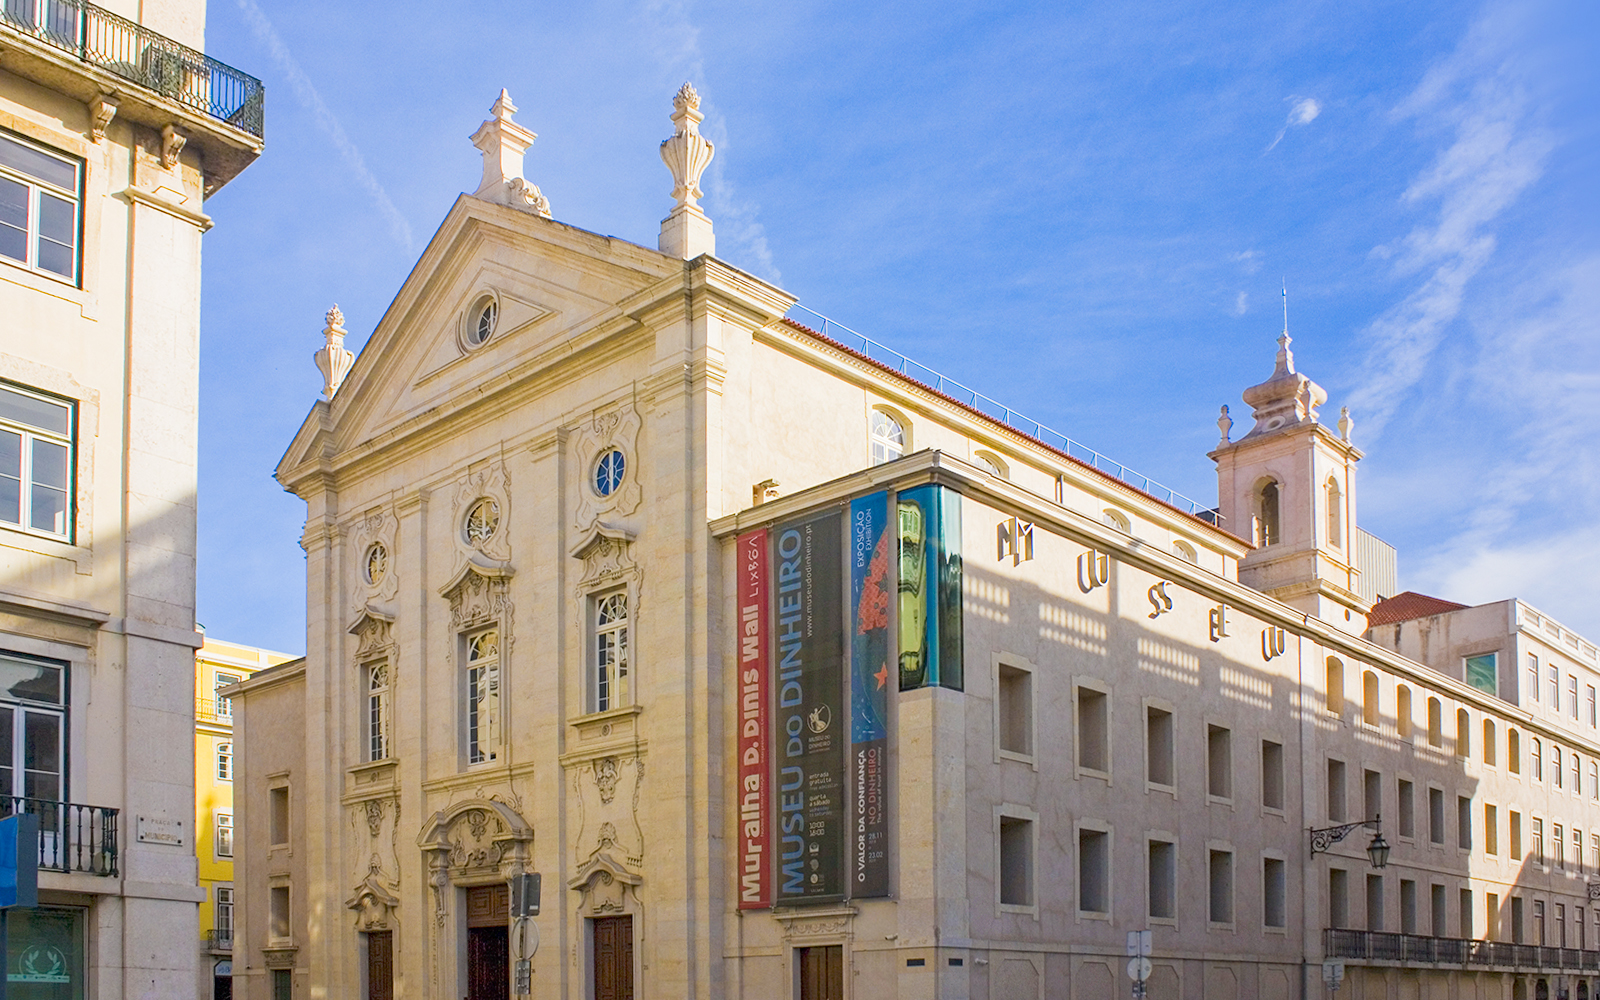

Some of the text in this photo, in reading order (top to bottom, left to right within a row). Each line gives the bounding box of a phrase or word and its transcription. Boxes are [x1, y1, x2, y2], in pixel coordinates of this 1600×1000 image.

[856, 510, 865, 568] EXPOSIÇÃO
[805, 523, 813, 638] www.museudodinheiro.pt
[742, 604, 759, 663] Wall
[778, 529, 805, 894] MUSEU DO DINHEIRO
[743, 741, 759, 766] D.
[858, 750, 866, 815] CONFIANÇA
[868, 748, 877, 825] NO DINHEIRO
[741, 773, 762, 902] Muralha
[858, 815, 865, 833] DA
[858, 872, 866, 883] O
[868, 851, 883, 859] 23.02
